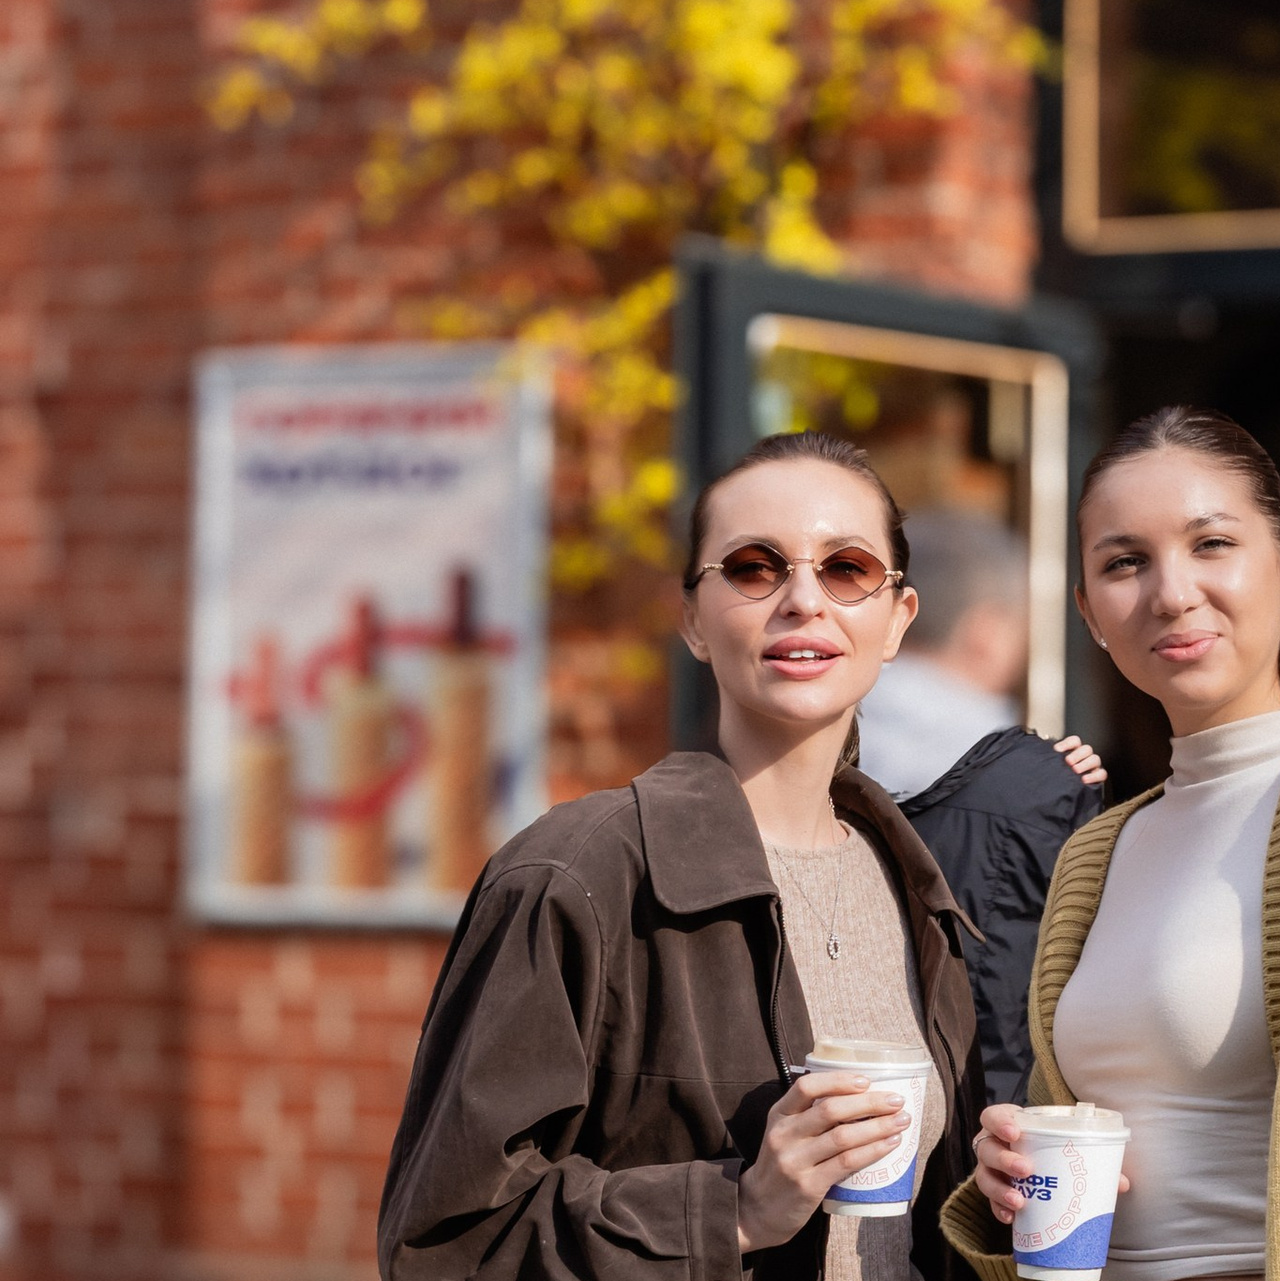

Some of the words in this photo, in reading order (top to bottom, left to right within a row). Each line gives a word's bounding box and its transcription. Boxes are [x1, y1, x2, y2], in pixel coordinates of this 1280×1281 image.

[849, 1167, 890, 1185] МЕ
[1012, 1184, 1052, 1202] АУЗ
[1013, 1229, 1044, 1248] МЕ
[1044, 1139, 1088, 1242] ГОРОДА
